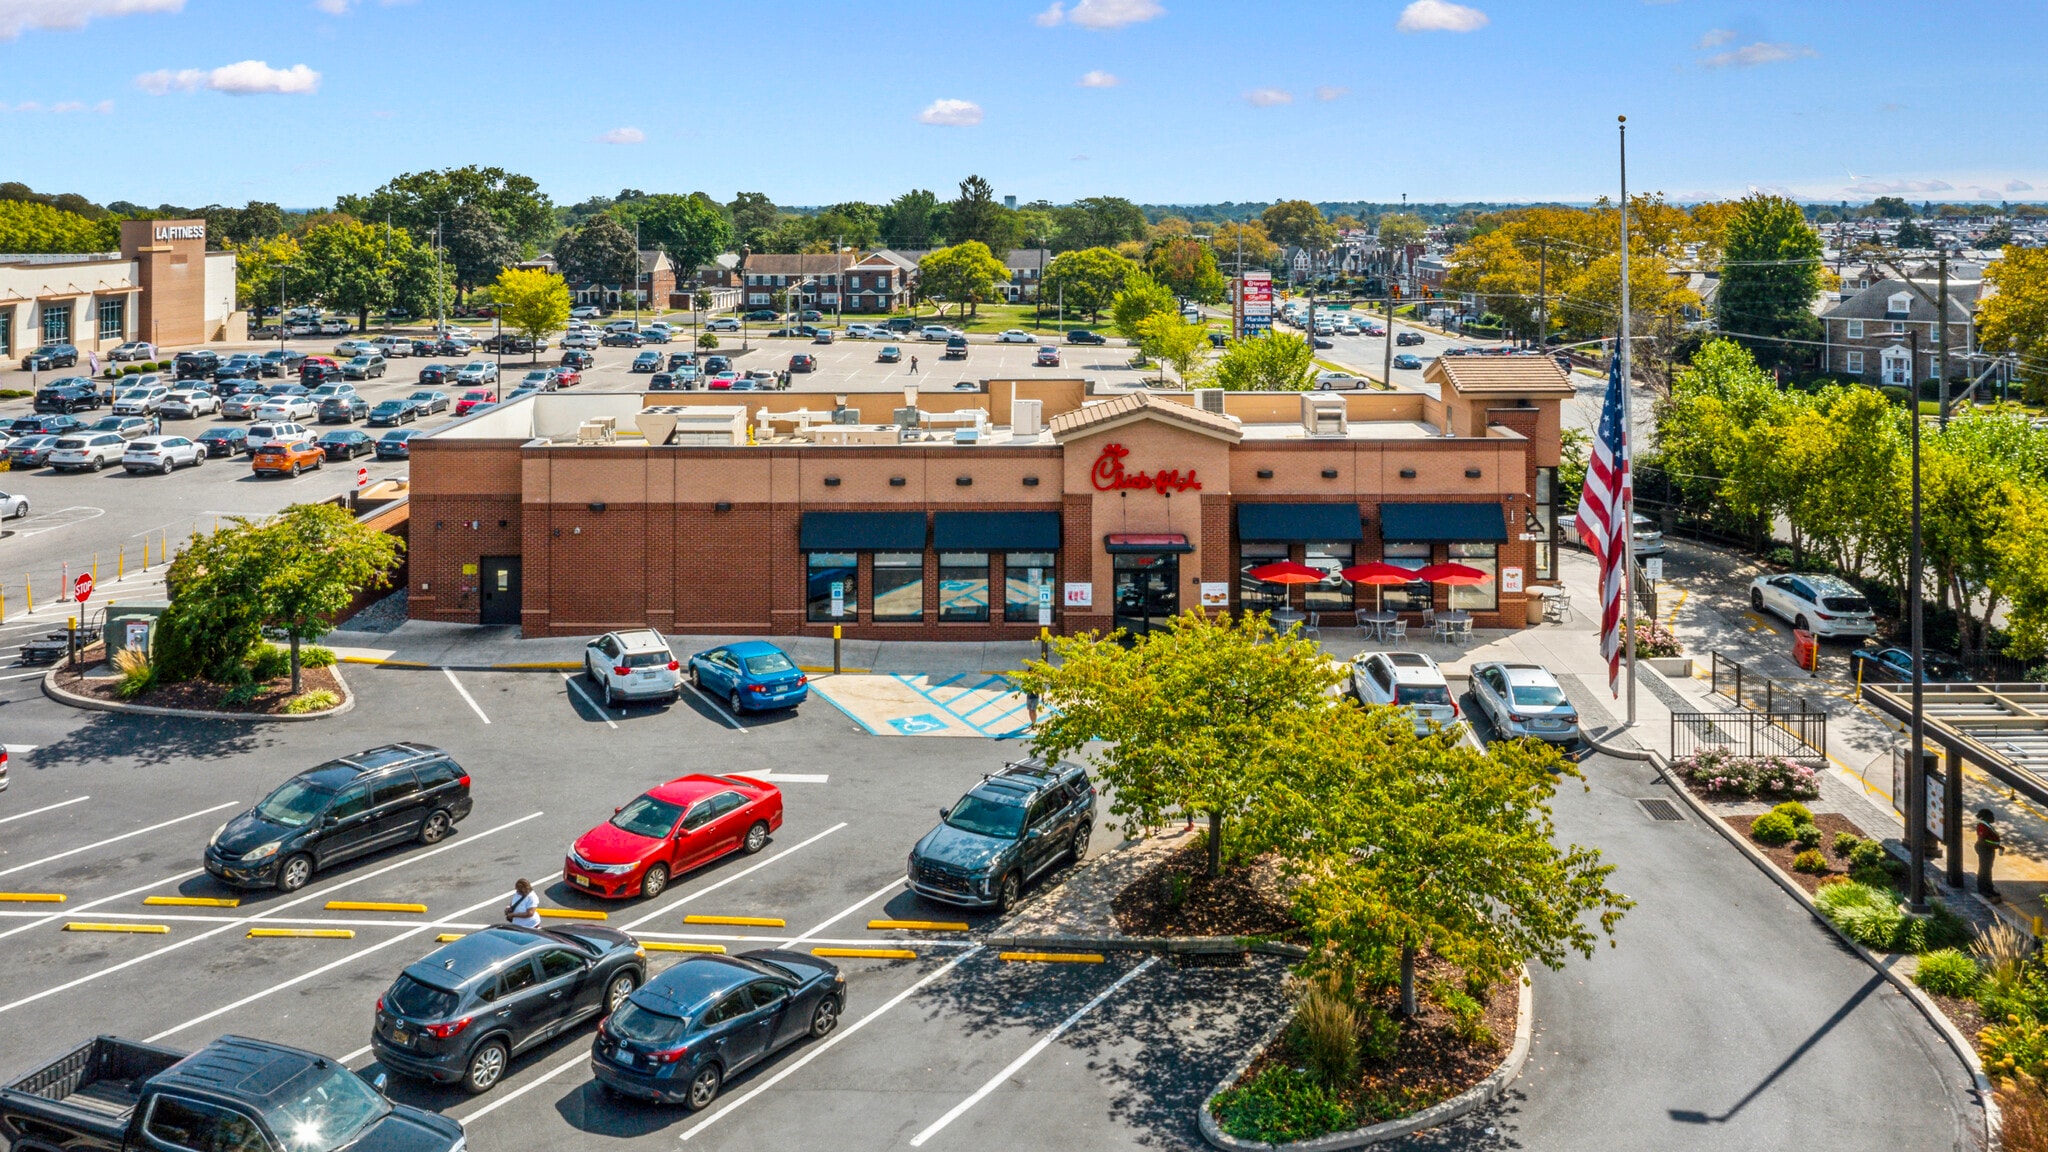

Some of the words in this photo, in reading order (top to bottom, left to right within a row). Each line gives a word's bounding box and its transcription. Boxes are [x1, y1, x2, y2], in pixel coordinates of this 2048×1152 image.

[156, 227, 168, 240] LA
[169, 225, 205, 239] FITNESS
[1091, 443, 1202, 495] Chick-fil-A
[75, 580, 92, 597] STOP
